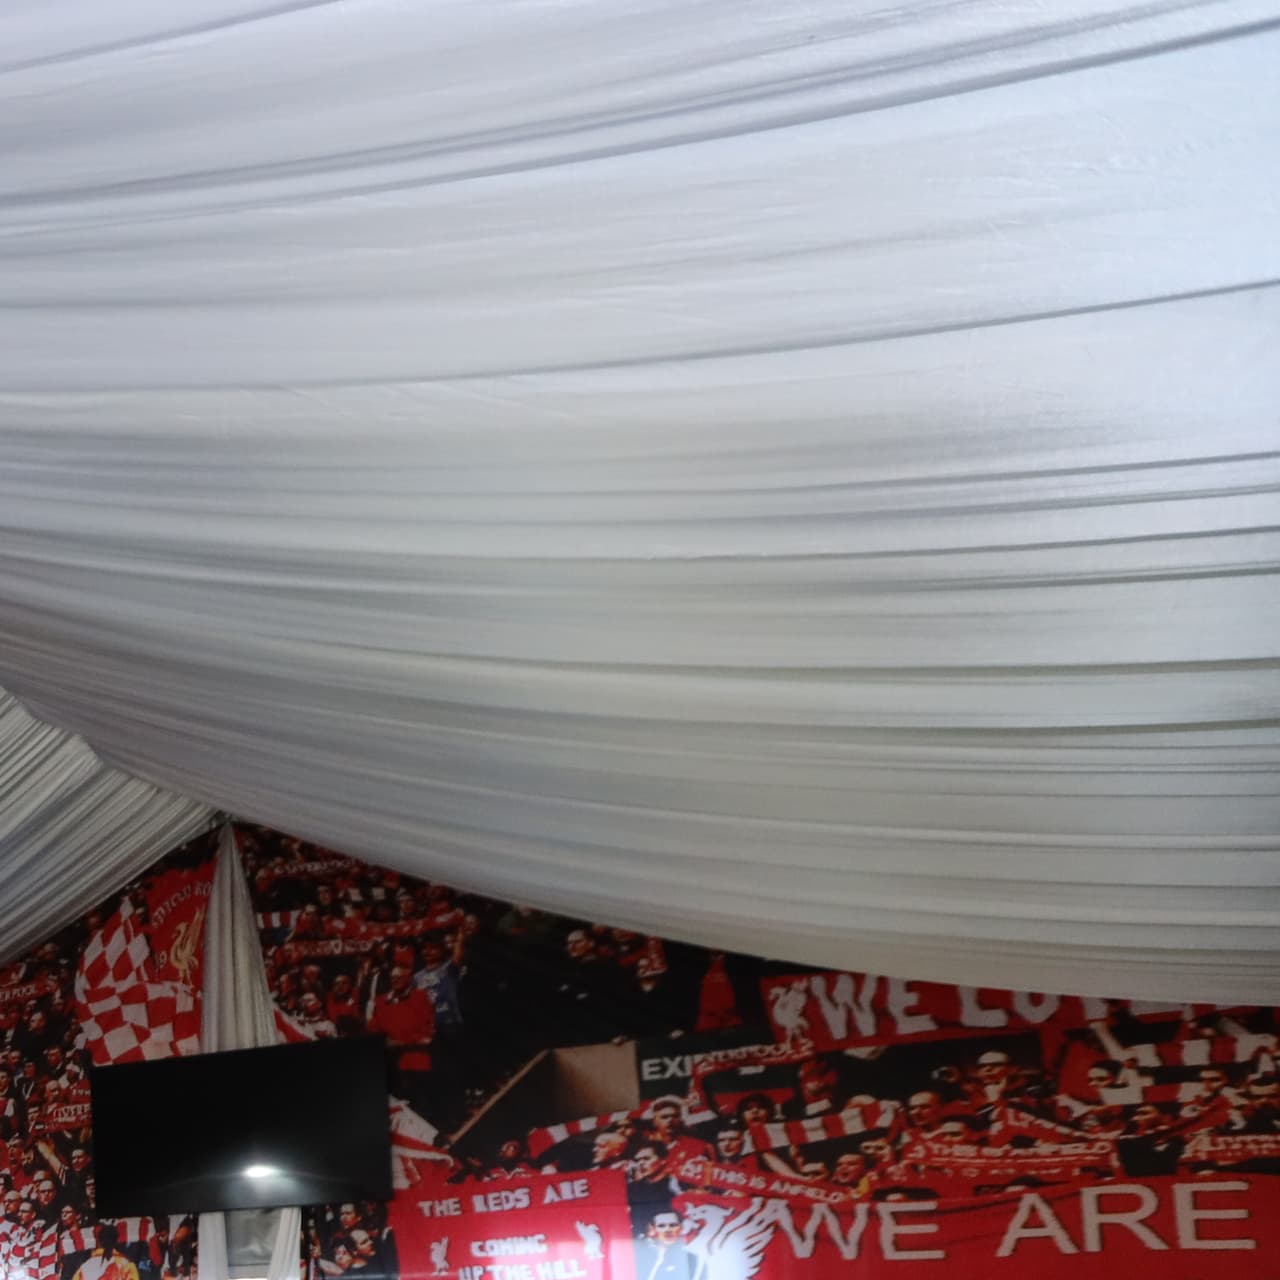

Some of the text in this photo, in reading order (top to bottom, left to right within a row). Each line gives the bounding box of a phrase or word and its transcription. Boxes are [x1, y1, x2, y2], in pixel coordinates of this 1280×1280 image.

[811, 973, 939, 1040] WE
[711, 1168, 747, 1186] THIS
[748, 1176, 766, 1189] IS
[418, 1198, 462, 1218] THE
[472, 1187, 531, 1214] REDS
[766, 1180, 1257, 1262] WE ARE
[470, 1234, 549, 1258] COMING
[536, 1258, 588, 1280] HILL
